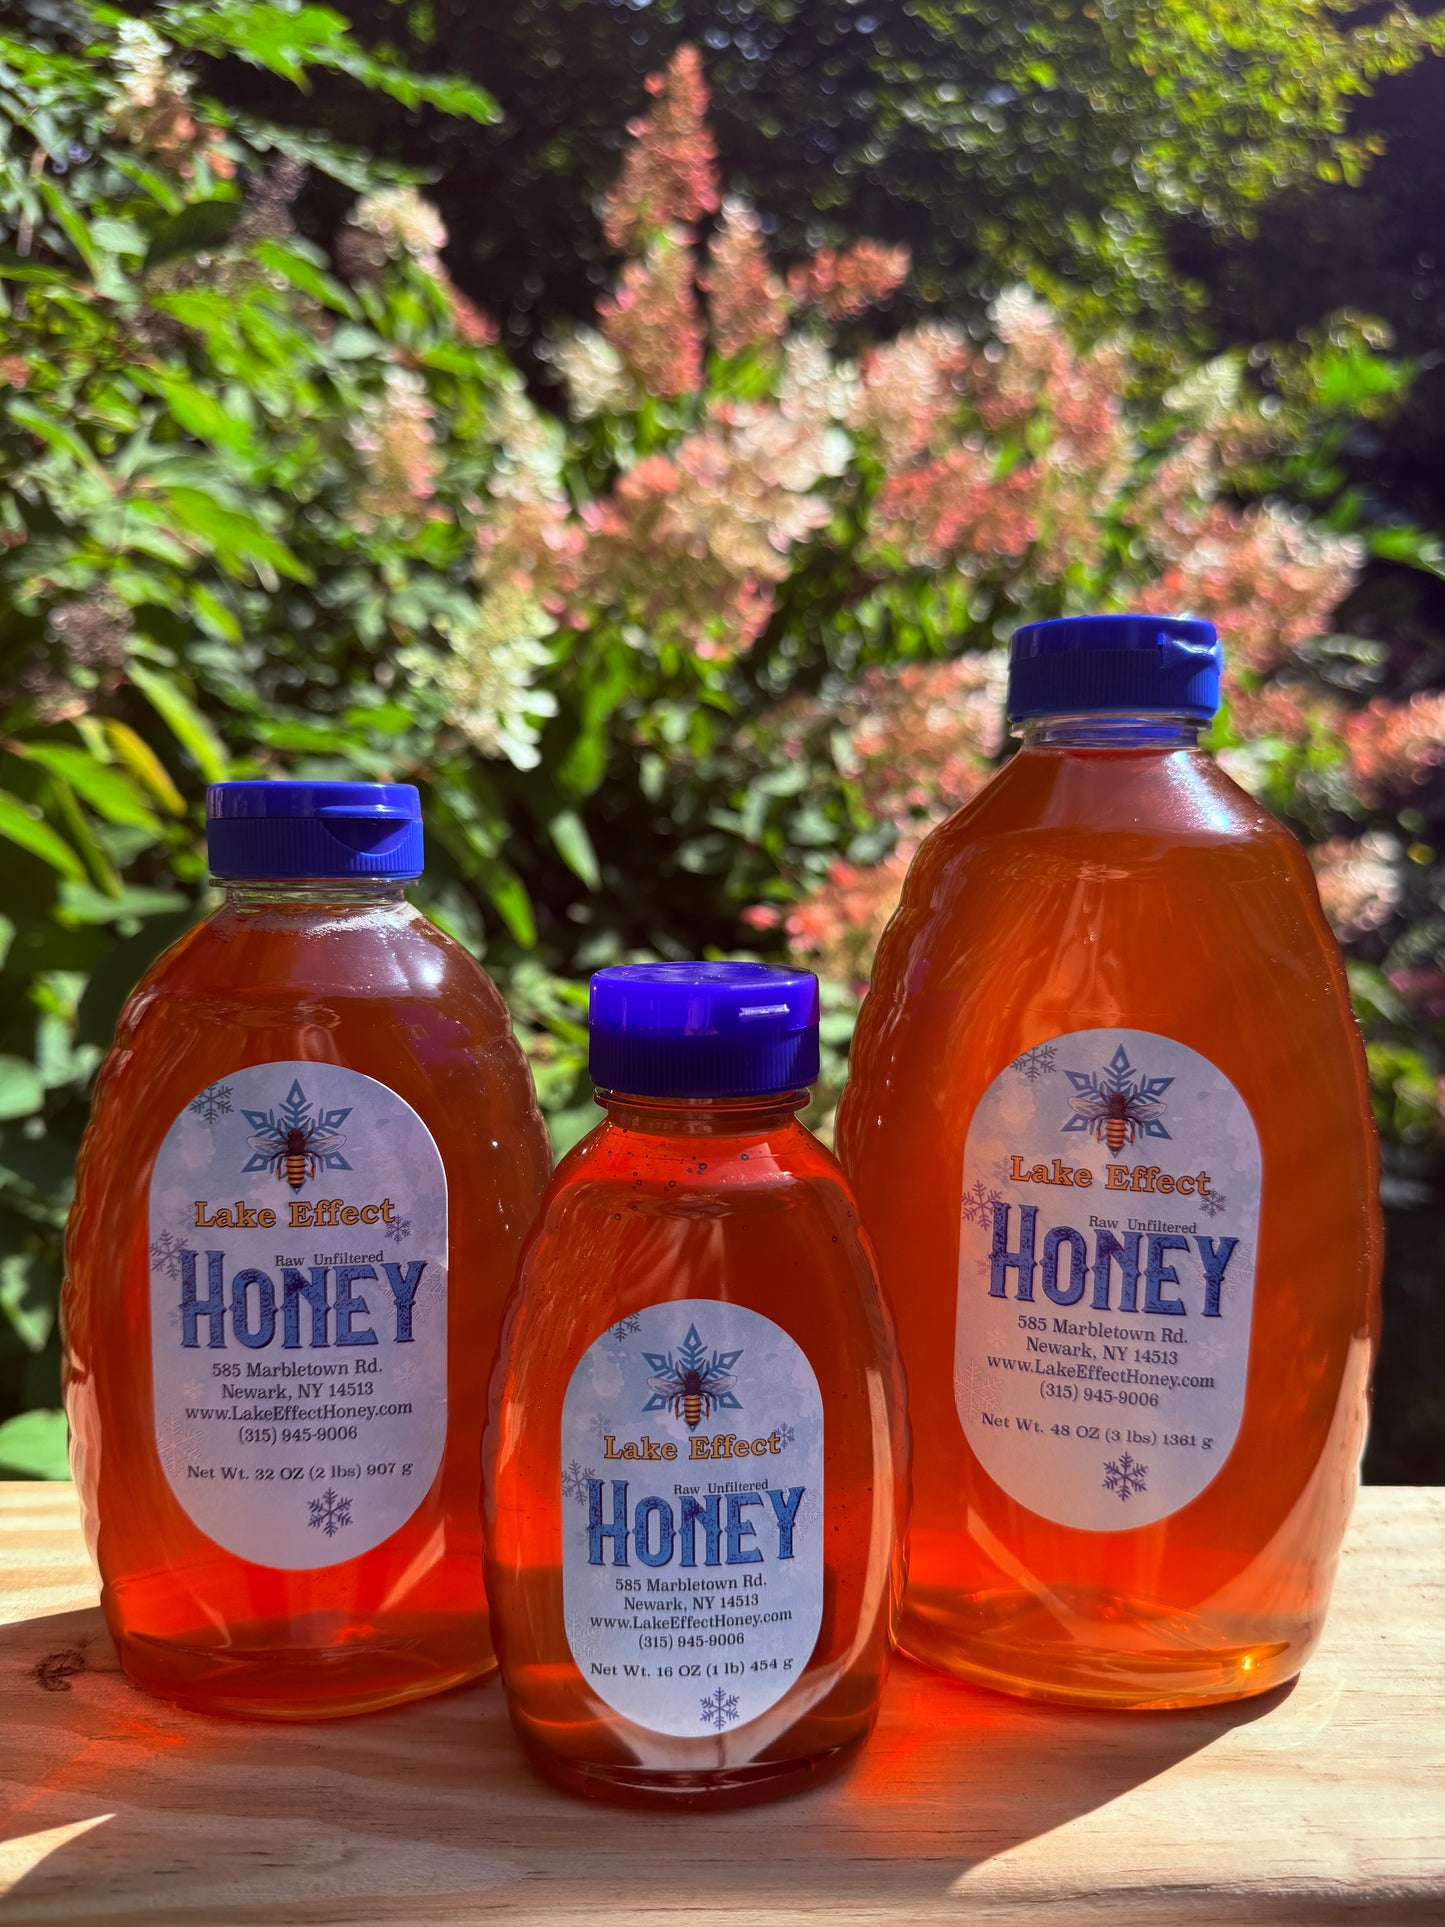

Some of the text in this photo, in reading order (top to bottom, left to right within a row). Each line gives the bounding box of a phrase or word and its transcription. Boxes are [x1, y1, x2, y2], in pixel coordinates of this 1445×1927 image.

[1010, 1156, 1211, 1196] Lake Effect
[194, 1199, 396, 1228] Lake Effect
[1089, 1215, 1197, 1234] Raw Unfiltered
[275, 1251, 384, 1268] Raw Unfiltered
[988, 1202, 1240, 1317] HONEY
[179, 1250, 428, 1349] HONEY
[1018, 1315, 1188, 1344] 585 Marbletown Rd.
[1026, 1337, 1178, 1365] Newark, NY 14513
[213, 1358, 383, 1378] 585 Marbletown Rd.
[986, 1355, 1215, 1391] www.LakeEffectHoney.com
[222, 1382, 374, 1401] Newark, NY 14513
[1040, 1381, 1159, 1407] (315) 945-9006
[185, 1401, 413, 1422] www.LakeEffectHoney.com
[238, 1425, 357, 1445] (315) 945-9006
[981, 1413, 1213, 1450] Net Wt. 48 OZ (3 lbs) 1361 g
[604, 1432, 781, 1461] Lake Effect
[188, 1462, 413, 1482] Net Wt. 32 OZ (2 lbs) 907 g
[674, 1480, 768, 1495] Raw Unfiltered
[586, 1479, 805, 1567] HONEY
[615, 1574, 766, 1591] 585 Marbletown Rd.
[624, 1594, 759, 1612] Newark, NY 14513
[590, 1608, 792, 1630] www.LakeEffectHoney.com
[639, 1632, 744, 1650] (315) 945-9006
[590, 1658, 793, 1677] Net Wt. 16 OZ (1 lb) 454 g
